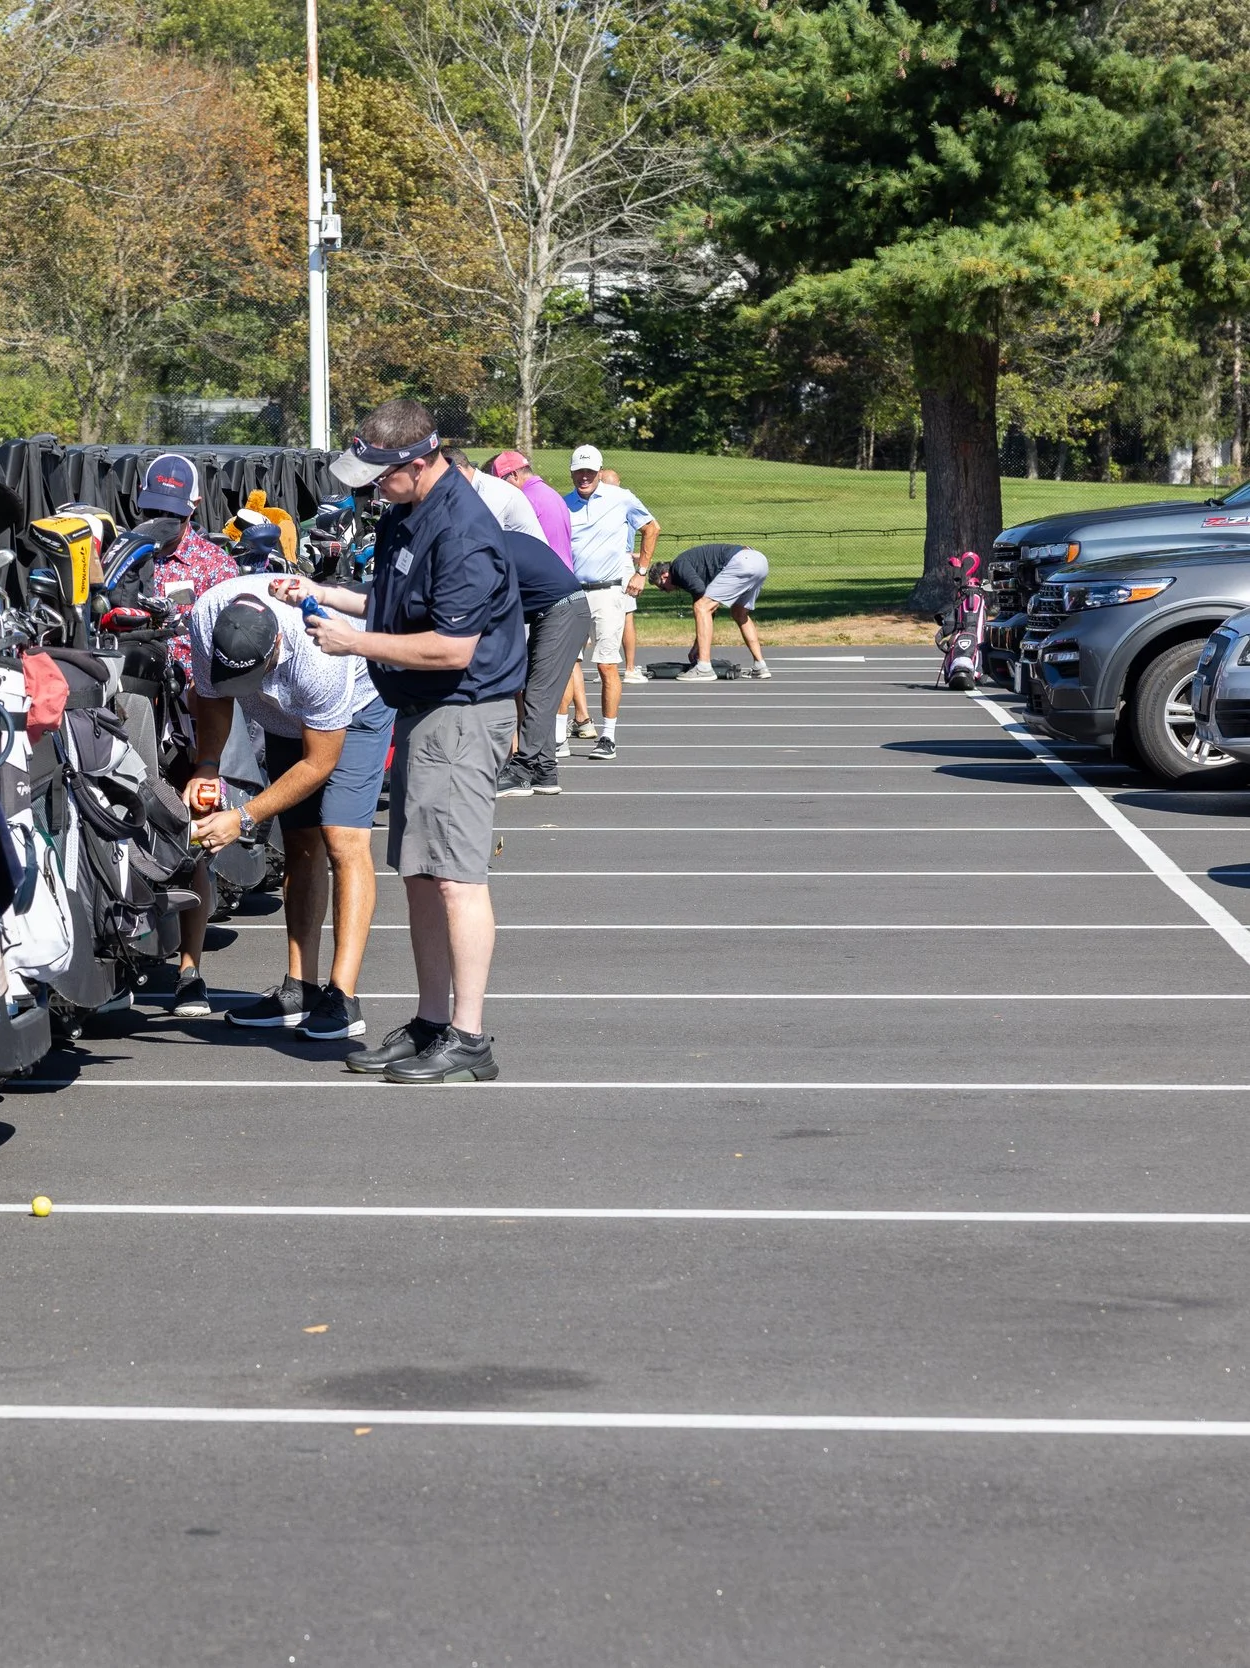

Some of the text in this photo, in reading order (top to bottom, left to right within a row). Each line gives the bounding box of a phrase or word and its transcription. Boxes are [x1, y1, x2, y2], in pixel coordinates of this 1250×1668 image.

[103, 537, 130, 564] PING
[79, 546, 88, 594] TaylorMade
[214, 648, 257, 669] Titleist
